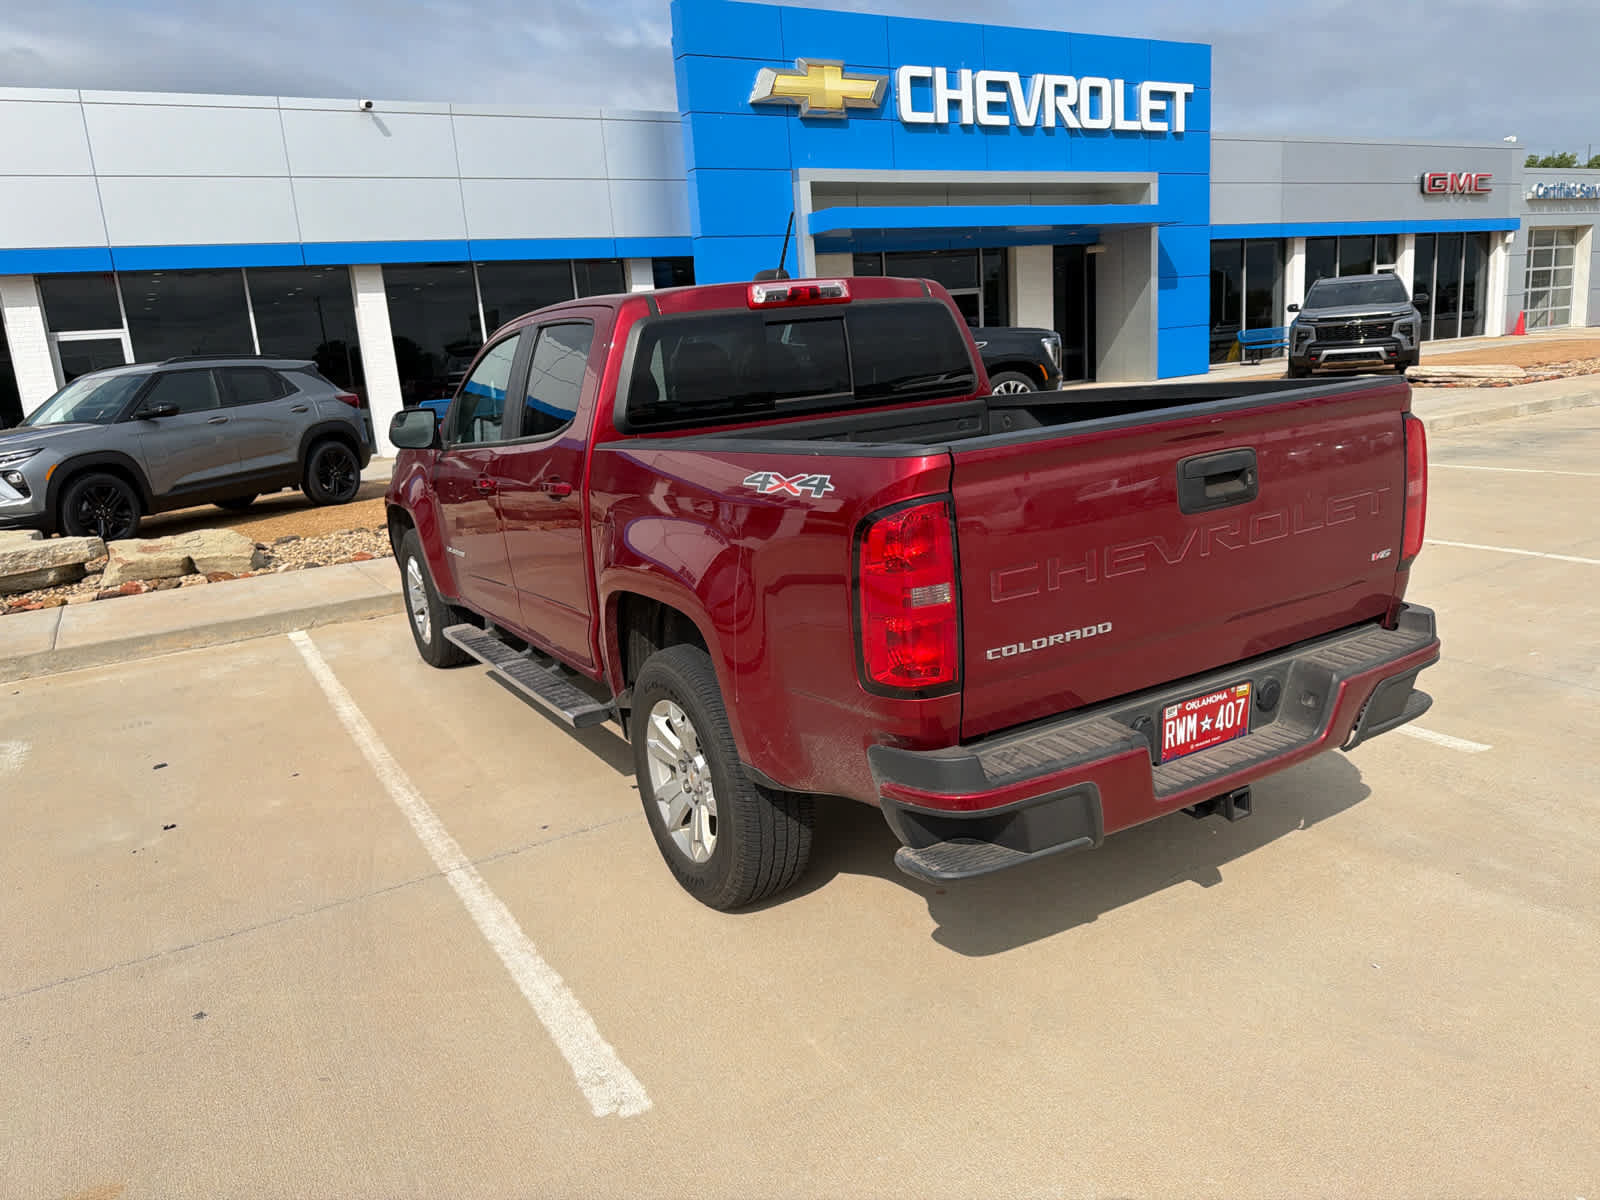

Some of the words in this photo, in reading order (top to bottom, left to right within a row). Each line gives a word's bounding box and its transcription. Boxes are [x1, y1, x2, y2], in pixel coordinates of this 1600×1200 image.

[896, 65, 1195, 133] CHEVROLET
[1424, 172, 1493, 193] GMC
[1536, 181, 1577, 200] Certified
[990, 487, 1392, 603] CHEVROLET
[986, 621, 1113, 661] COLORADO
[1185, 691, 1228, 711] OKLAHOMA
[1164, 712, 1198, 750] RWM
[1214, 698, 1246, 732] 407
